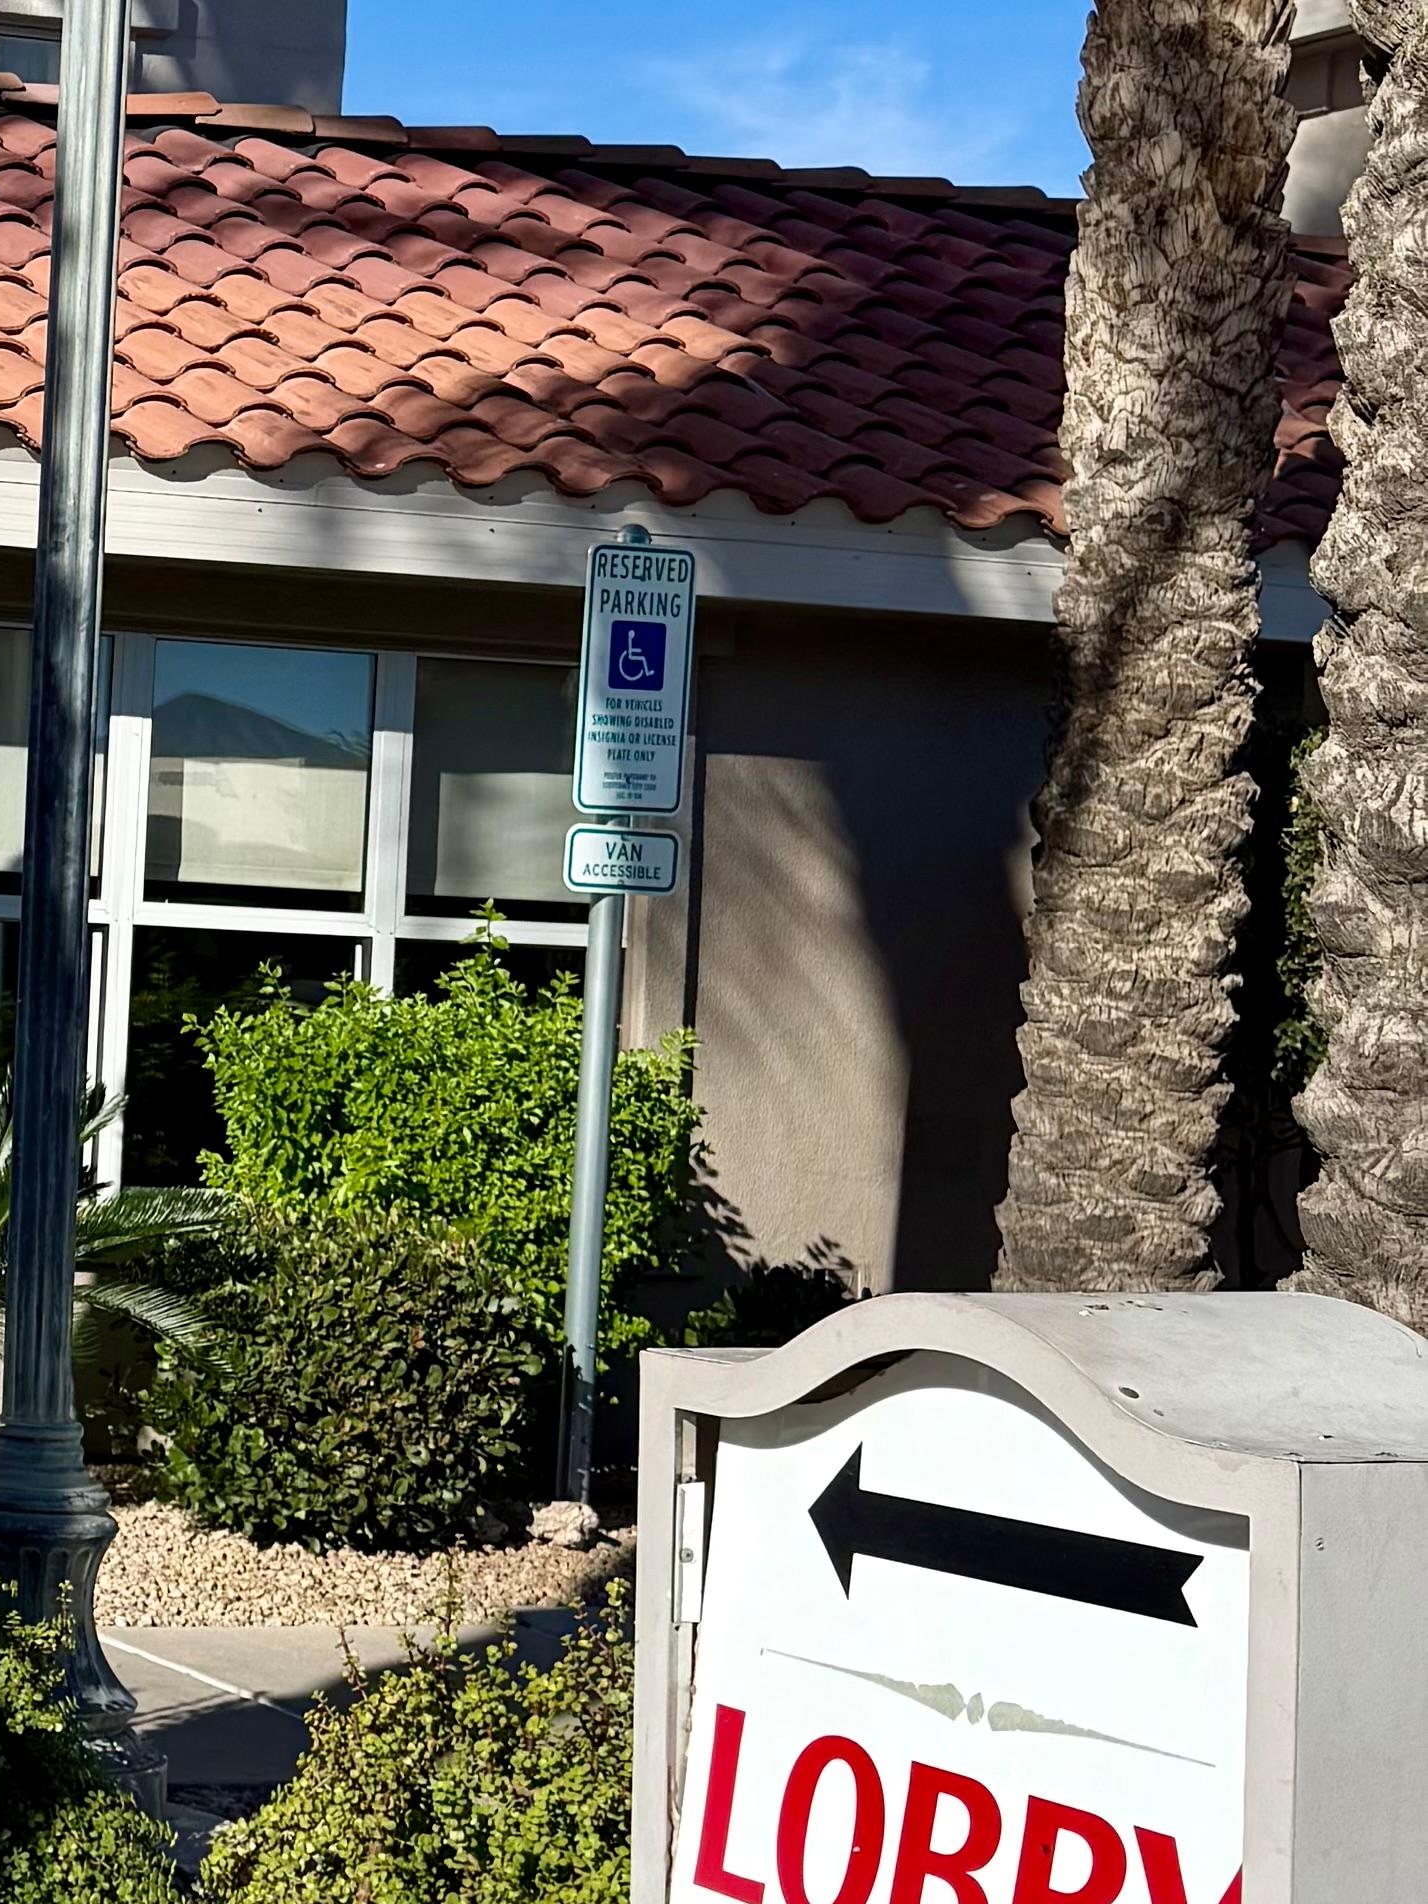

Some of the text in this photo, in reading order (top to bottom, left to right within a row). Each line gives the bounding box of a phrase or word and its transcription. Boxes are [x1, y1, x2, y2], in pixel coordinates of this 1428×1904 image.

[597, 552, 689, 583] RESERVED
[600, 588, 681, 618] PARKING
[605, 697, 663, 712] FOR VEHICLES
[592, 714, 674, 729] SHOWING DISABLED
[588, 731, 676, 746] INSIGNIA OR LICENSE
[607, 748, 655, 762] PLATE ONLY
[605, 841, 642, 862] VAN
[583, 863, 661, 880] ACCESSIBLE
